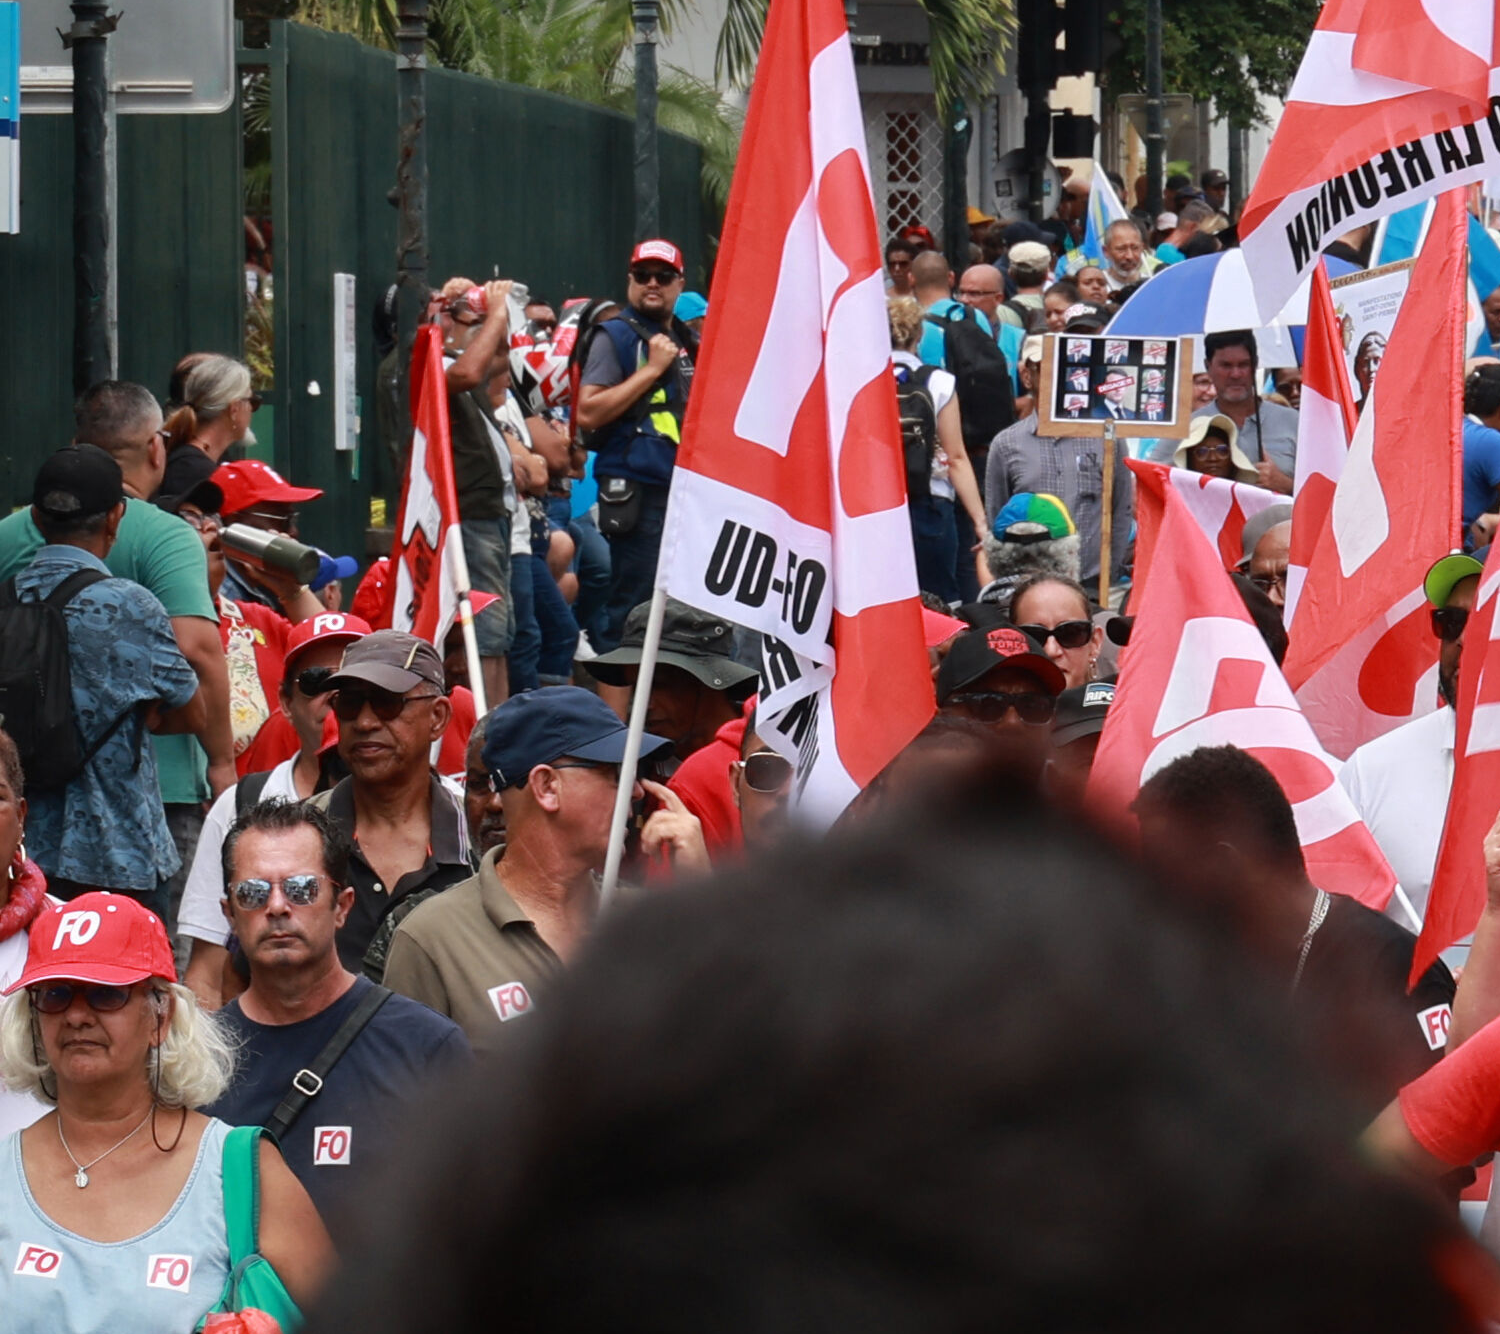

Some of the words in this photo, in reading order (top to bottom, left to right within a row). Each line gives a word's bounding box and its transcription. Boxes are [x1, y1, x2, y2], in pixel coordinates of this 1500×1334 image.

[705, 519, 827, 635] UD-FO
[313, 612, 348, 635] FO
[1085, 690, 1116, 703] RIPC
[52, 909, 102, 949] FO
[497, 983, 530, 1015] FO
[1421, 1009, 1451, 1046] FO
[316, 1130, 350, 1160] FO
[18, 1245, 61, 1274] FO
[149, 1256, 190, 1289] FO
